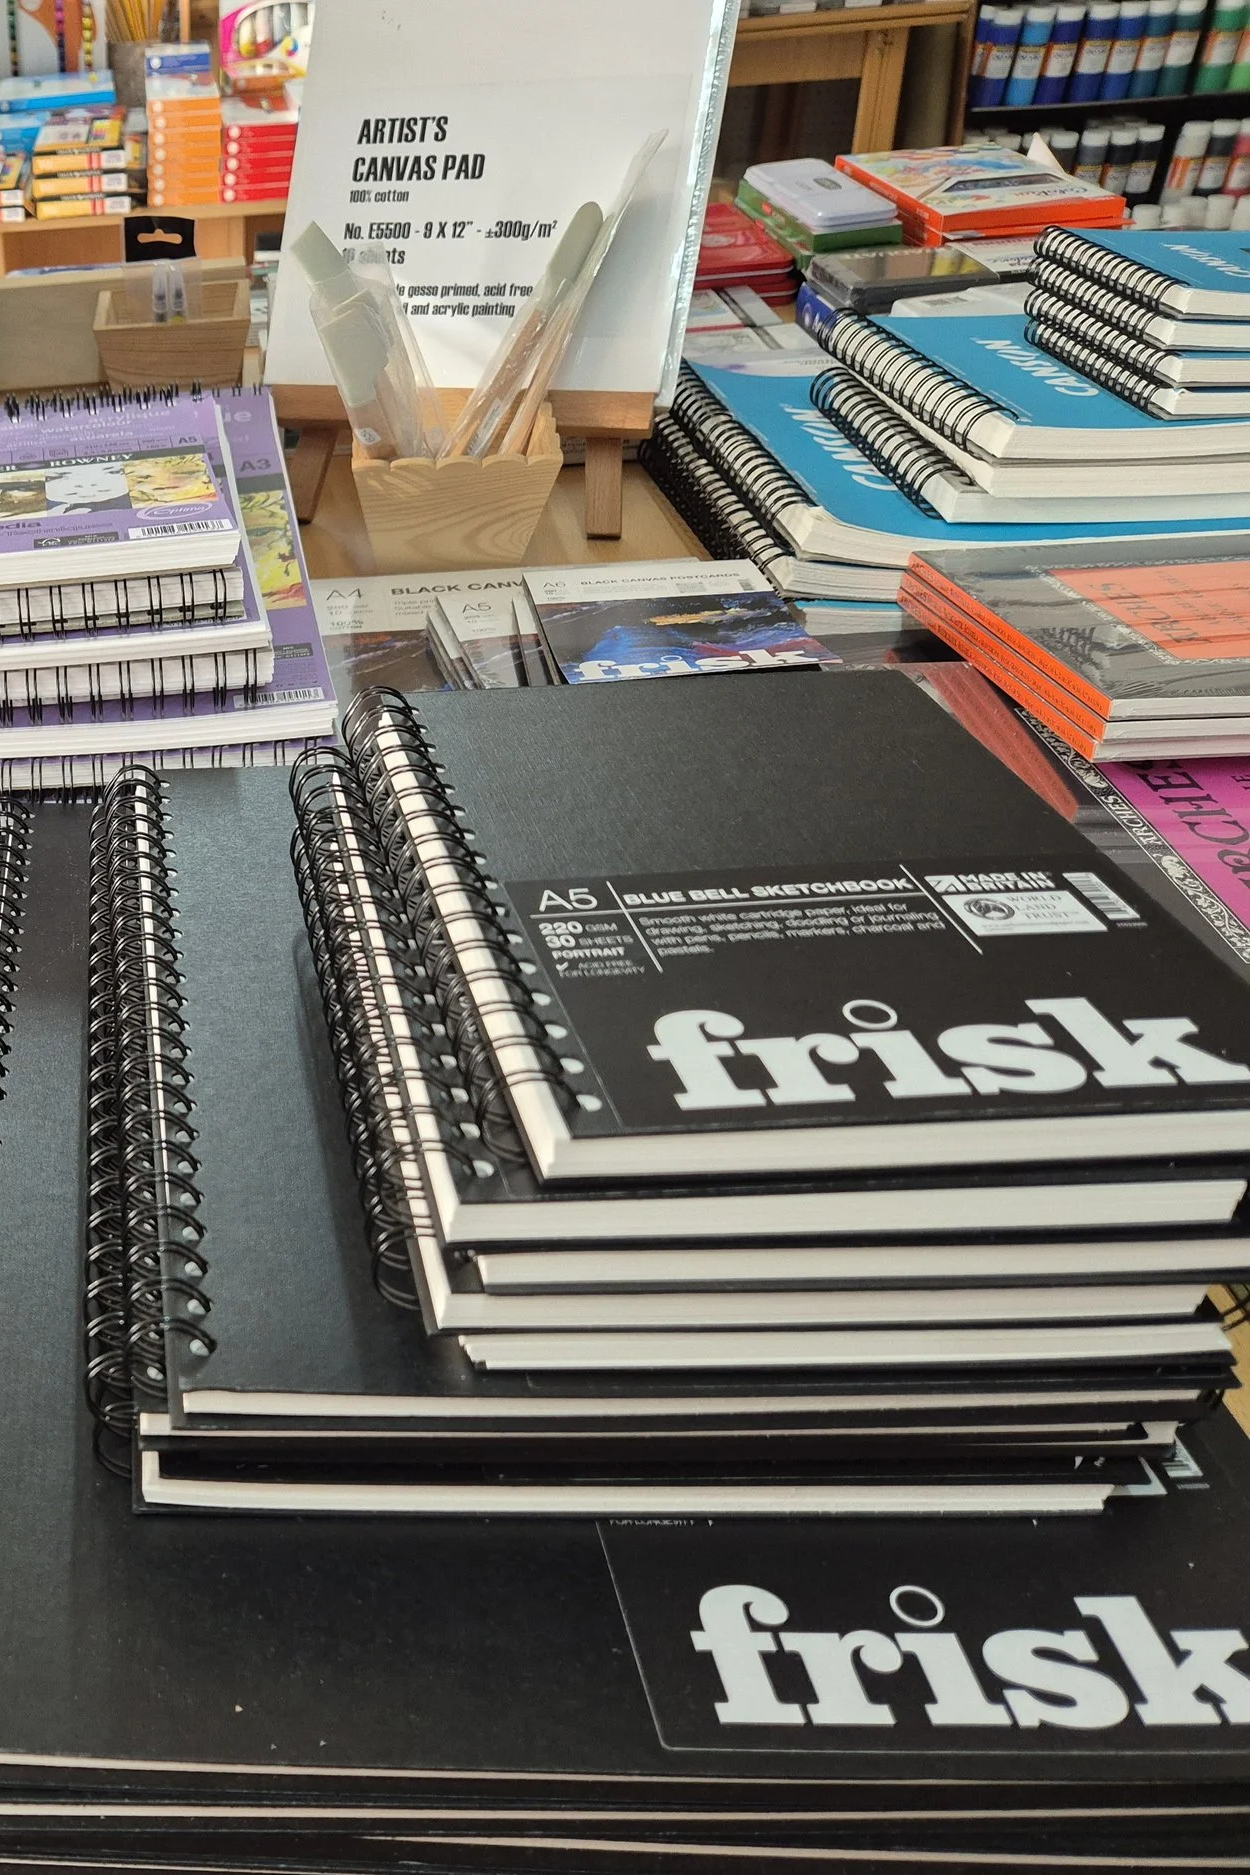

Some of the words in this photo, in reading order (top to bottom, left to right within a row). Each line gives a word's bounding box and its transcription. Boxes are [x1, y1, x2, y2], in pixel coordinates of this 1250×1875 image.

[356, 116, 449, 145] ARTIST'S
[351, 155, 437, 182] CANVAS
[441, 154, 486, 181] PAD
[349, 190, 372, 203] 100%
[374, 190, 409, 203] cotton
[343, 223, 364, 240] No.
[368, 222, 411, 240] E5500
[408, 286, 439, 299] gesso
[440, 284, 480, 299] primed,
[483, 284, 506, 297] acid
[509, 284, 533, 297] free
[411, 302, 429, 316] and
[432, 303, 469, 317] acrylic
[472, 303, 516, 318] painting
[977, 339, 1100, 397] CANSON
[178, 436, 197, 445] A5
[50, 453, 133, 467] ROWNEY
[240, 459, 271, 472] A3
[580, 577, 618, 585] BLACK
[621, 575, 667, 583] CANVAS
[669, 572, 741, 581] POSTCARDS
[325, 588, 365, 601] A4
[391, 584, 460, 596] BLACK
[462, 603, 492, 613] A5
[574, 648, 808, 681] frisk
[1100, 795, 1162, 845] ARCHES
[958, 872, 1020, 883] MADE
[622, 890, 687, 905] BLUE
[688, 887, 750, 901] BELL
[750, 878, 914, 898] SKETCHBOOK
[963, 880, 1057, 891] BRITAIN
[539, 888, 598, 912] A5
[1014, 903, 1058, 911] LAND
[638, 915, 697, 927] Smooth
[698, 910, 737, 923] white
[739, 907, 803, 920] cartridge
[851, 903, 886, 914] ideal
[785, 916, 849, 928] doodling
[866, 911, 940, 924] journaling
[539, 921, 583, 936] 220
[851, 922, 914, 935] charcoal
[916, 920, 946, 930] and
[545, 934, 576, 948] 30
[578, 934, 634, 946] SHEETS
[552, 946, 625, 960] PORTRAIT
[646, 997, 1250, 1112] frisk
[690, 1584, 1250, 1729] frisk
